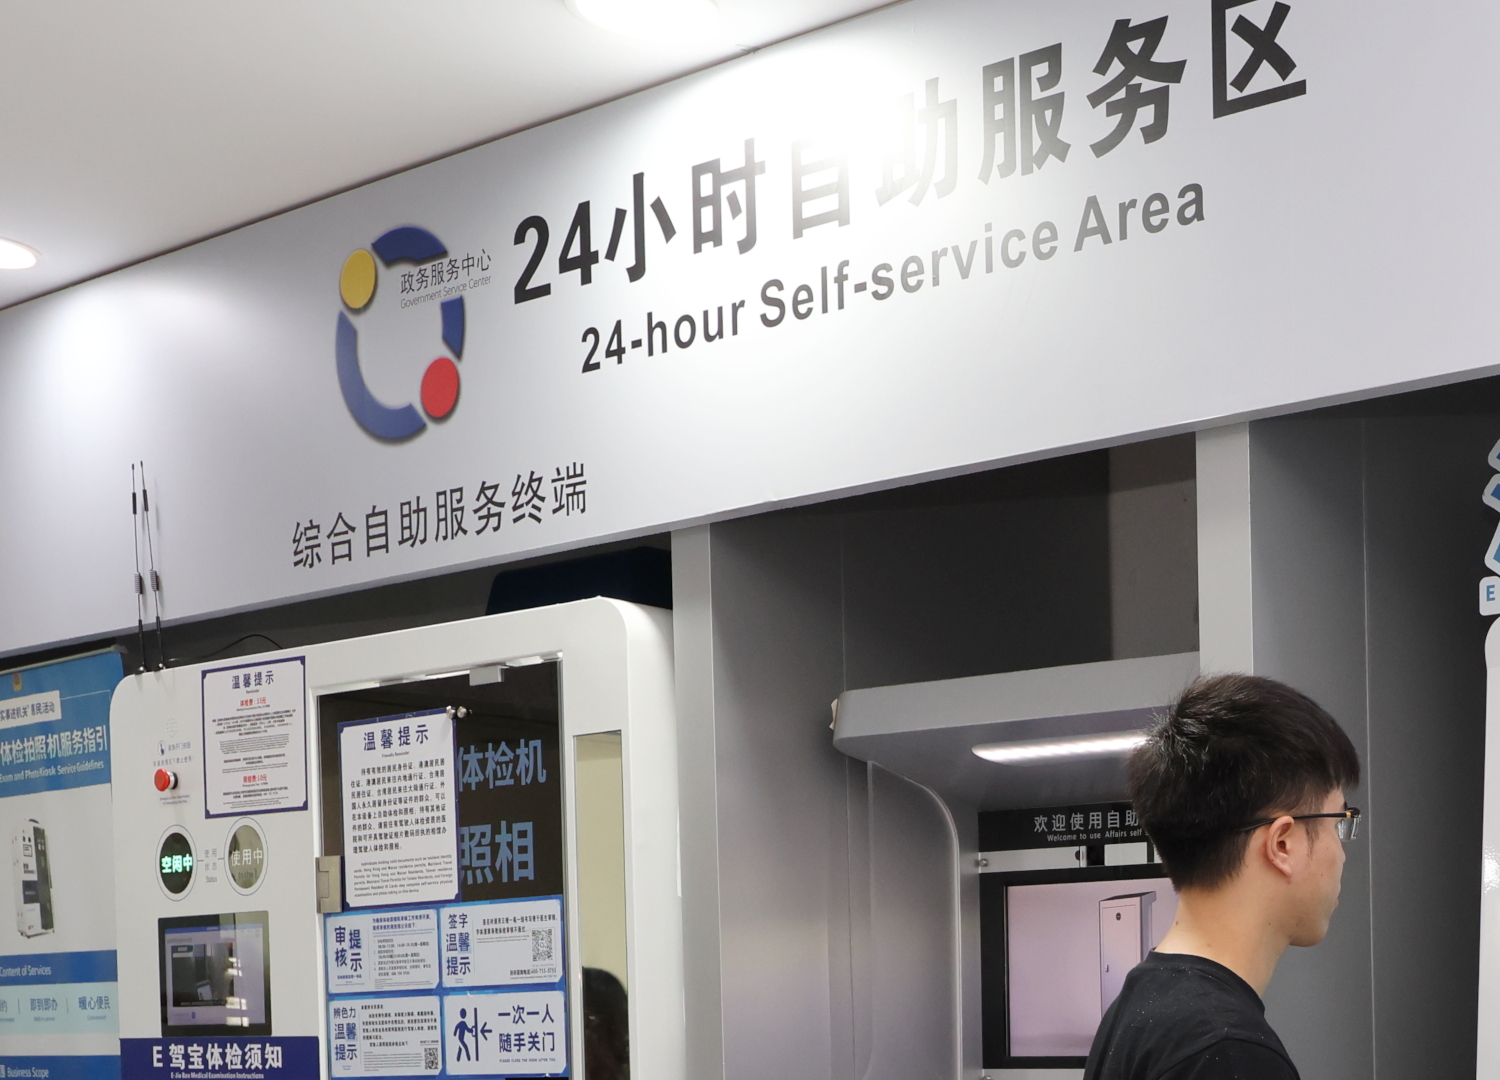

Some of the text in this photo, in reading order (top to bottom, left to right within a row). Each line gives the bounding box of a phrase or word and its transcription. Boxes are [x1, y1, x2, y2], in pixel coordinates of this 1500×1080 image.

[512, 0, 1307, 305] 24小时自助服务区
[401, 248, 492, 294] 政务服务中心
[581, 182, 1206, 373] 24-hour Self-service Area
[401, 274, 492, 309] Government Service Center
[291, 461, 588, 571] 综合自助服务终端
[1485, 584, 1496, 602] E
[232, 670, 274, 689] 温馨提示
[363, 724, 428, 751] 温馨提示
[40, 765, 56, 777] Kiosk
[57, 765, 76, 775] Service
[457, 739, 546, 792] 体检机
[1034, 810, 1139, 832] 欢迎使用自助
[1047, 834, 1077, 842] Welcome
[1105, 830, 1127, 838] Affairs
[1130, 828, 1142, 836] self
[230, 849, 263, 866] 使用中
[460, 821, 535, 885] 照相
[161, 854, 193, 874] 空闲中
[448, 913, 468, 929] 签字
[334, 926, 347, 967] 审核
[349, 929, 362, 972] 提示
[446, 932, 470, 952] 温馨
[28, 965, 51, 976] Services
[447, 956, 471, 976] 提示
[333, 1006, 356, 1019] 辨色力
[498, 1003, 554, 1025] 一次一人
[335, 1022, 356, 1040] 温馨
[499, 1031, 555, 1053] 随手关门
[153, 1042, 283, 1070] E 驾宝体检须知
[335, 1044, 357, 1061] 提示
[7, 1067, 49, 1079] Business Scope
[191, 1071, 208, 1079] Medical
